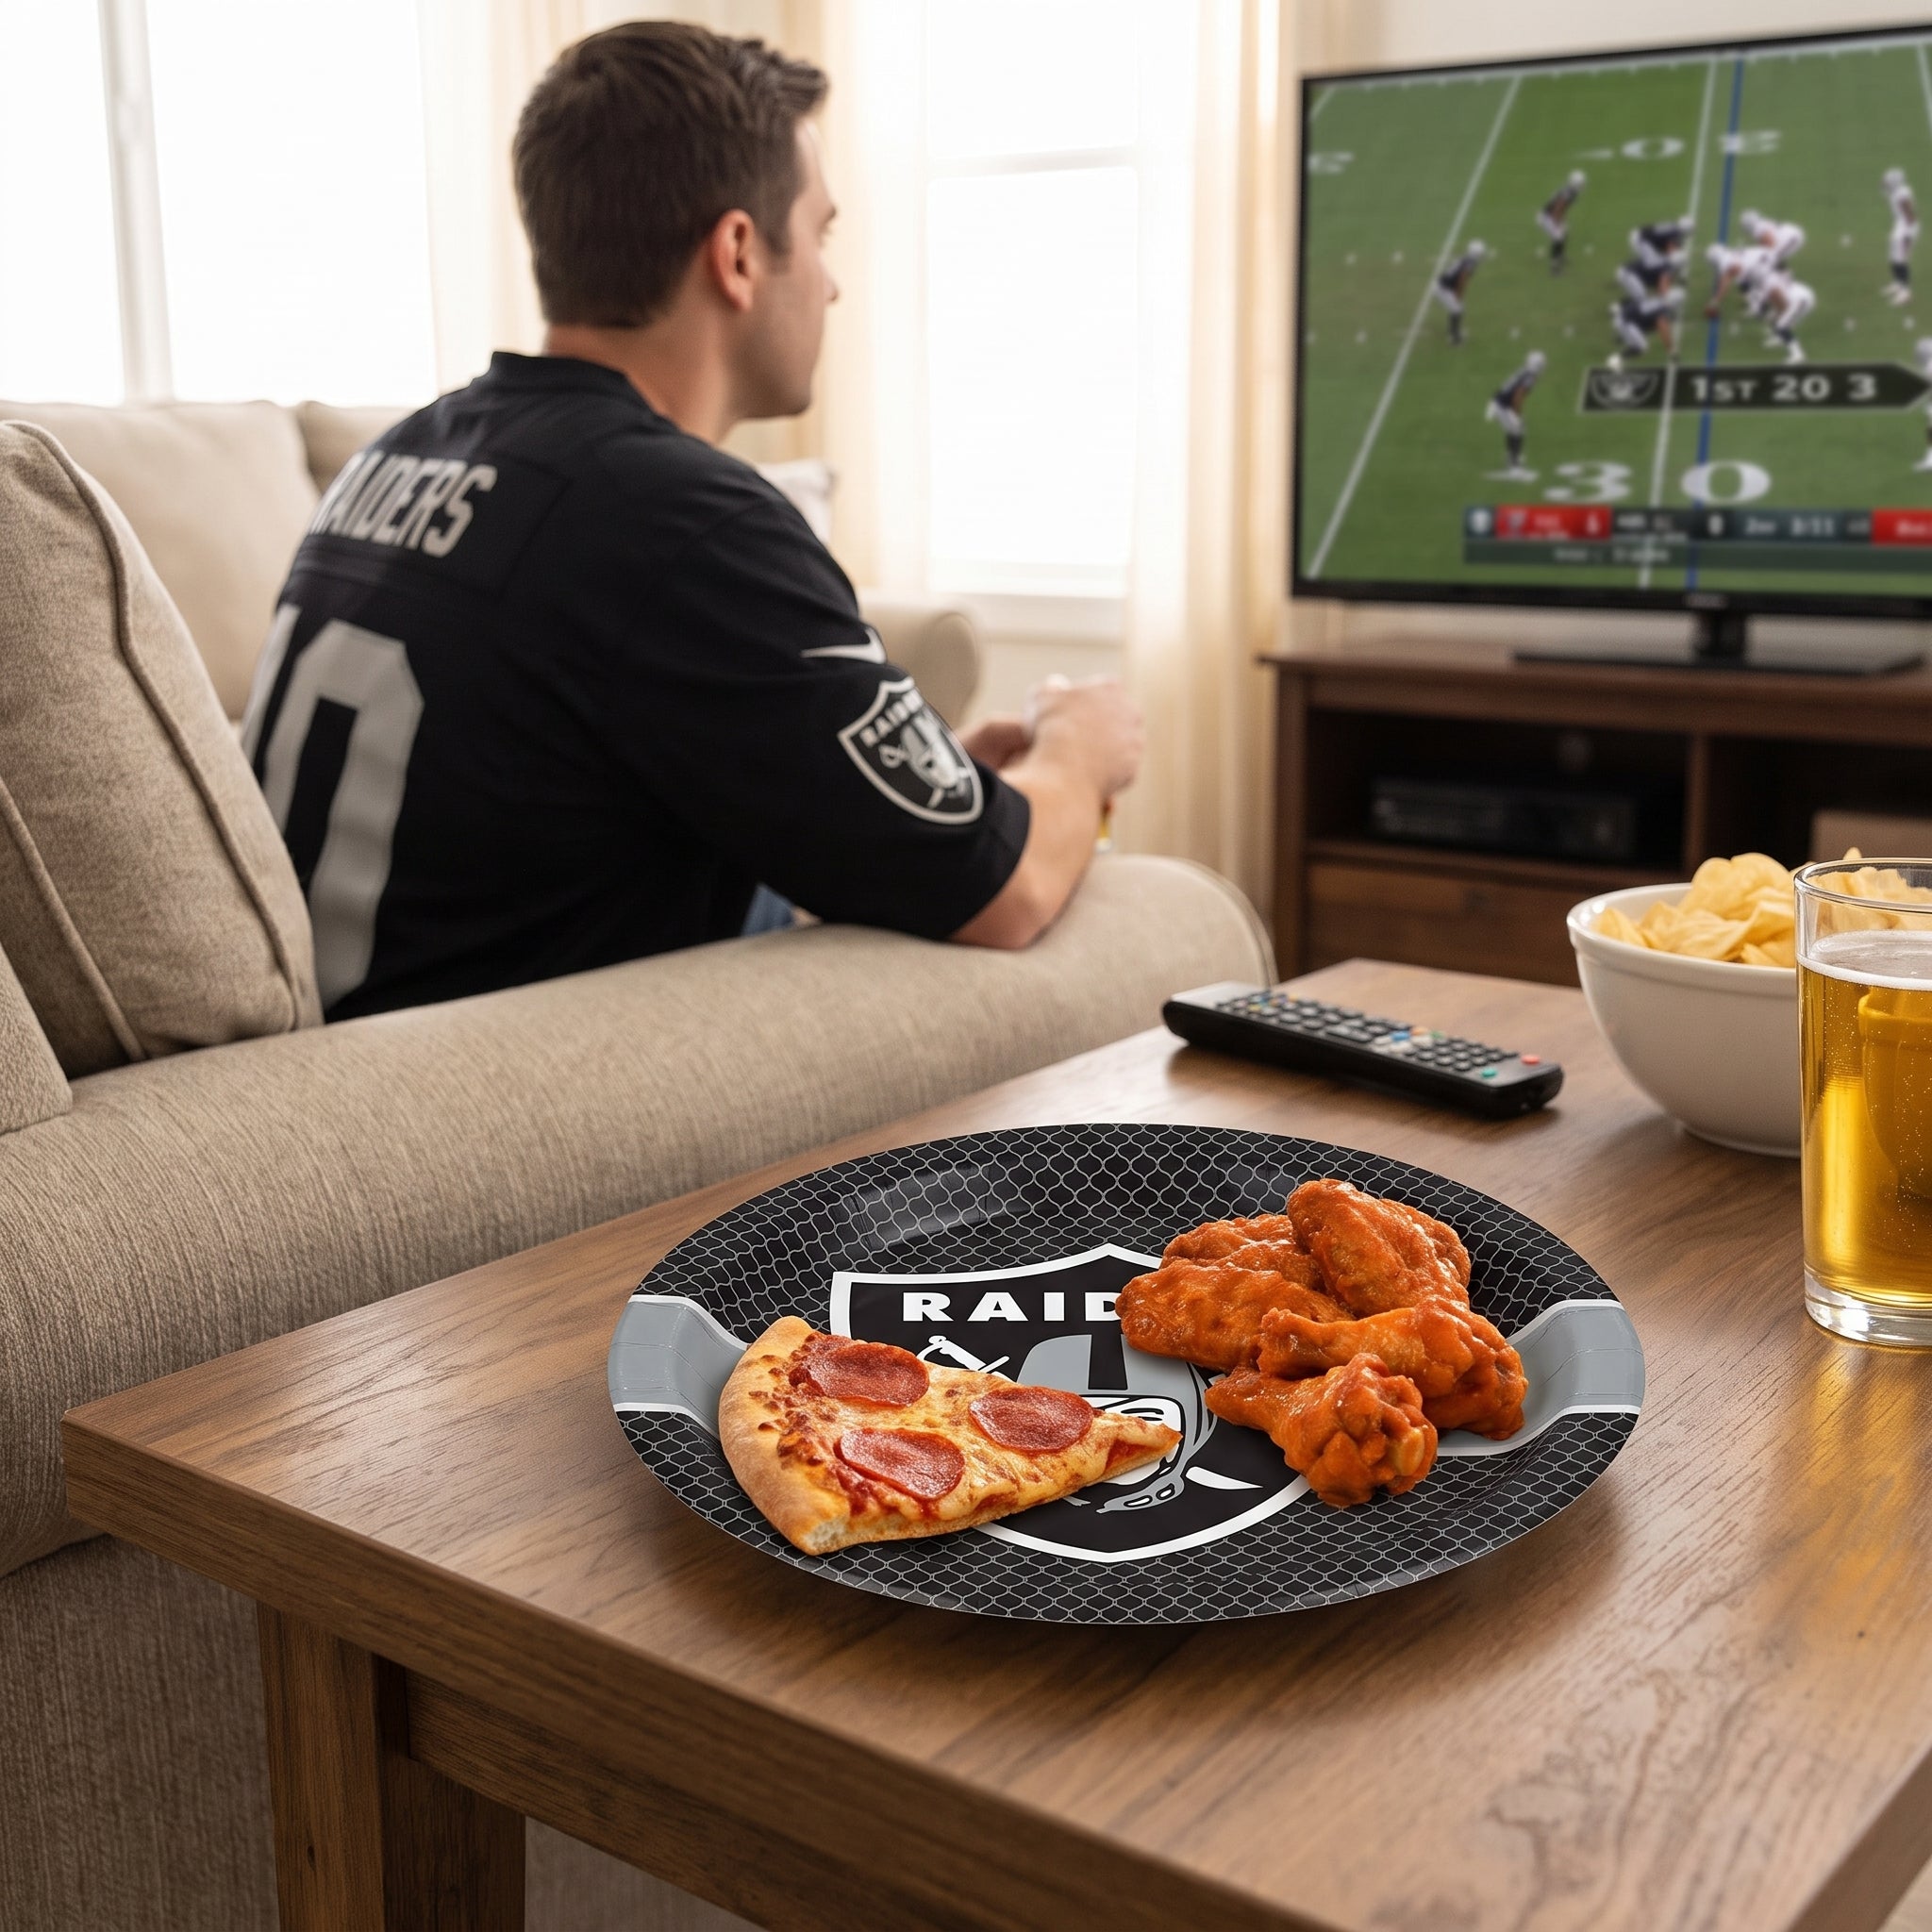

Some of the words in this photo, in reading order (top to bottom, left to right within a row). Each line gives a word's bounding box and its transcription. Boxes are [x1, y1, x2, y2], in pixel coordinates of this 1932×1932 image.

[1691, 375, 1757, 402] 1ST
[1772, 375, 1831, 402] 20
[1846, 374, 1878, 402] 3
